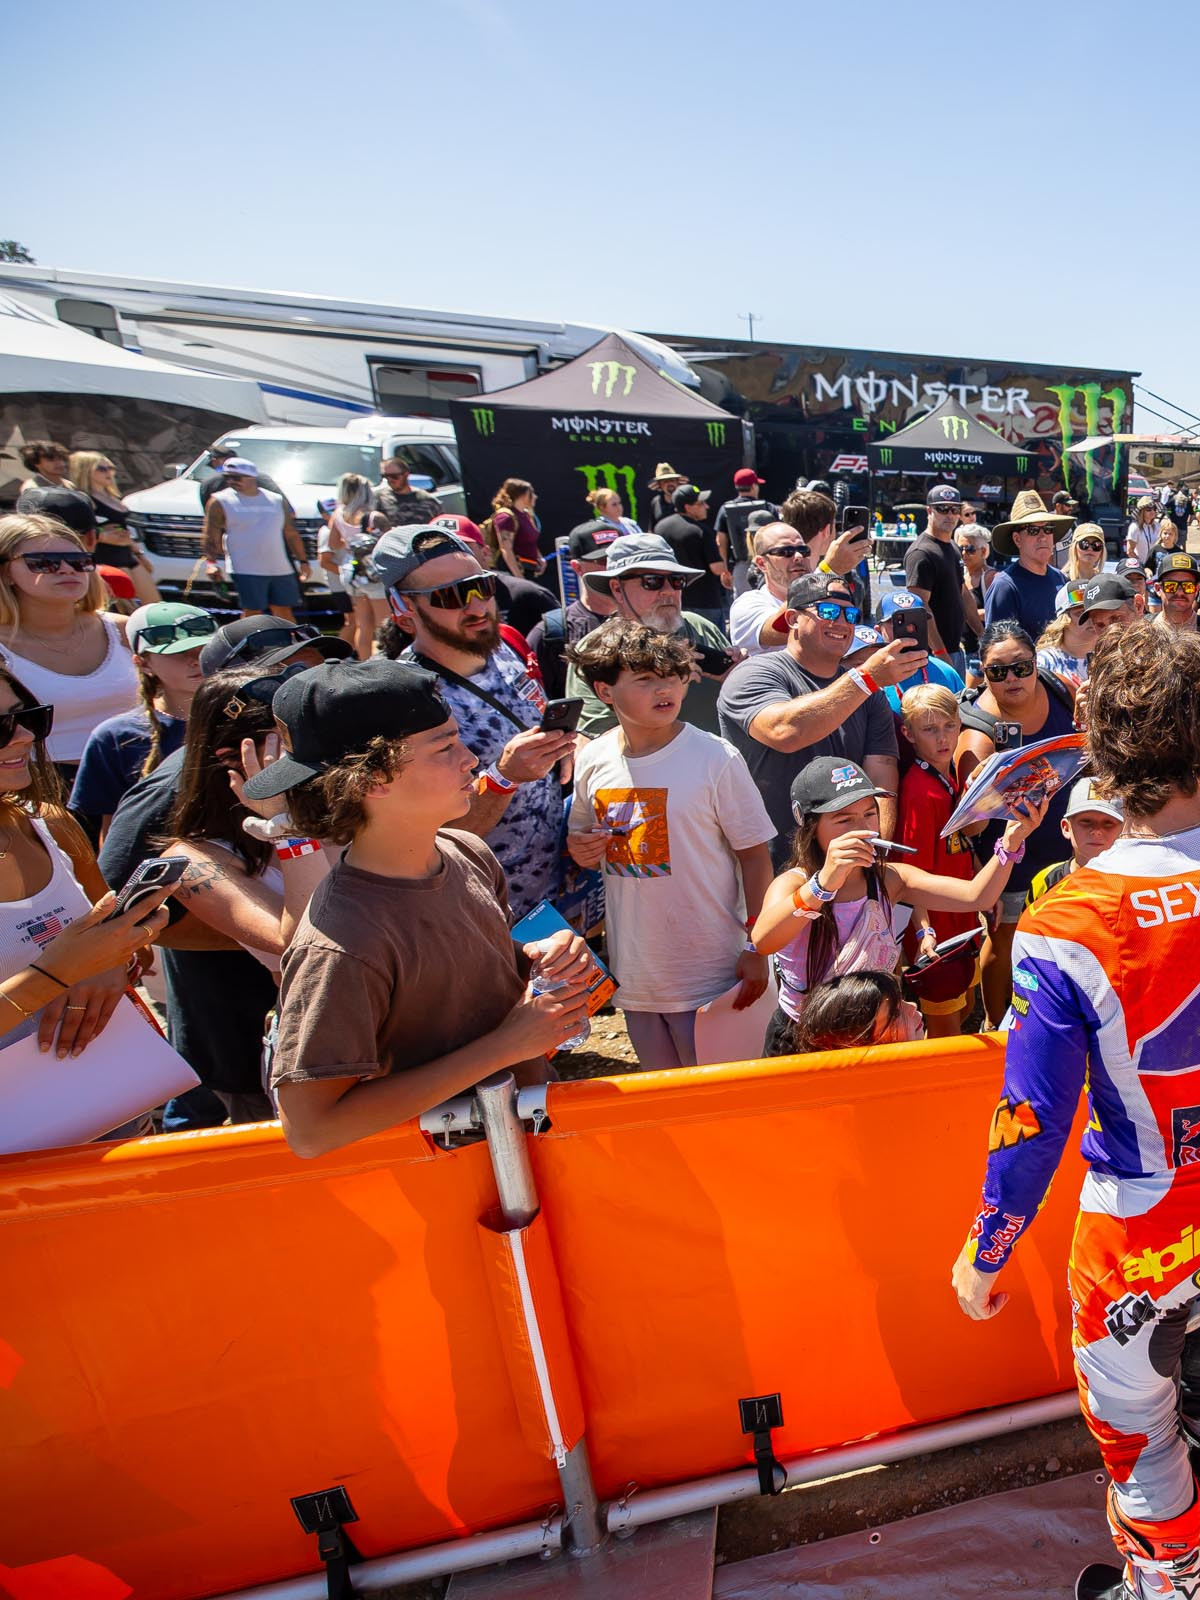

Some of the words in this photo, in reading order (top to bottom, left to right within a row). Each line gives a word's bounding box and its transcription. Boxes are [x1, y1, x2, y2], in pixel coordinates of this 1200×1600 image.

[552, 416, 652, 436] MONSTER
[924, 451, 984, 465] MONSTER
[836, 777, 864, 791] FOX
